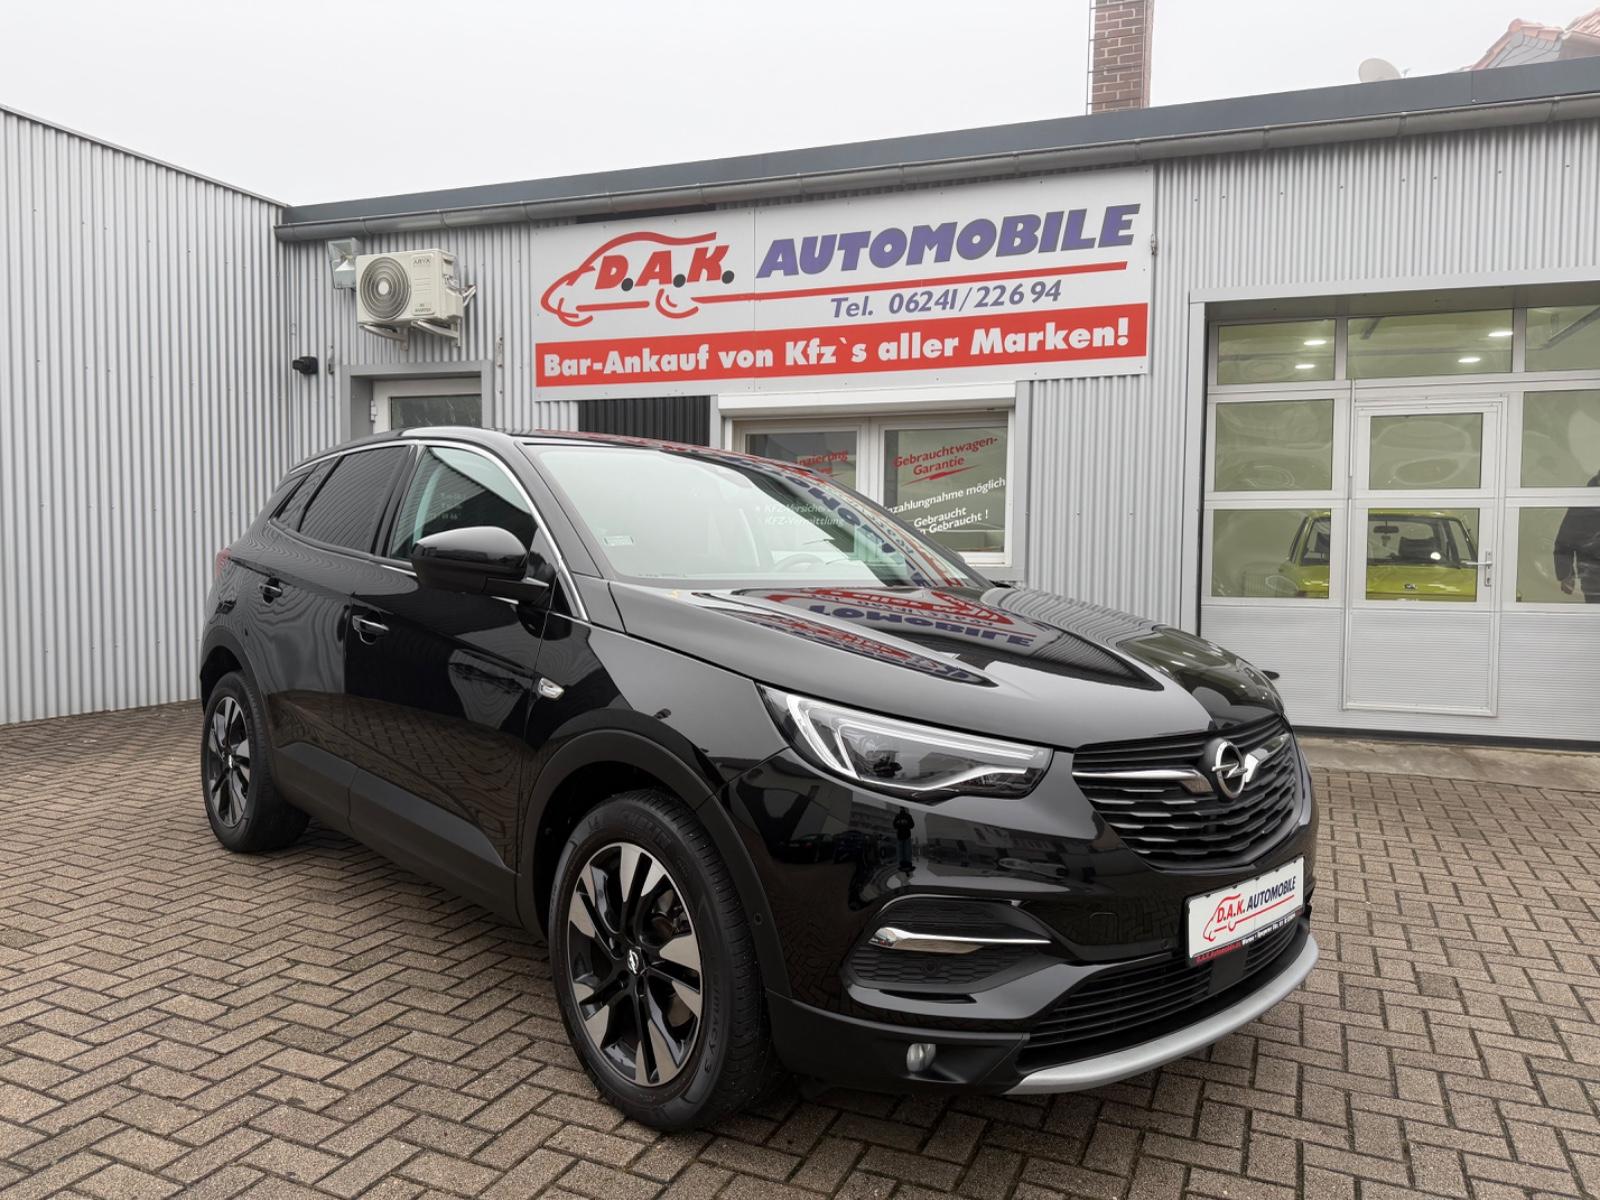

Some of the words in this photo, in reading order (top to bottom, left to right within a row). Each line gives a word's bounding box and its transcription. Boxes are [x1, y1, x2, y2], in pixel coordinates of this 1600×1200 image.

[595, 244, 735, 292] D.A.K.
[756, 203, 1141, 279] AUTOMOBILE
[831, 296, 874, 318] Tel.
[543, 344, 709, 378] Bar-Ankauf
[717, 348, 774, 369] von
[878, 331, 959, 361] aller
[970, 317, 1129, 356] Marken!
[893, 437, 998, 469] Gebrauchtwagen-
[913, 456, 965, 475] Garantie
[884, 489, 964, 513] nzahlungnahme
[966, 476, 1006, 495] möglich
[913, 507, 967, 527] Gebraucht
[929, 512, 983, 534] Gebraucht
[1216, 899, 1246, 924] D.A.K.
[1246, 876, 1296, 911] AUTOMOBILE
